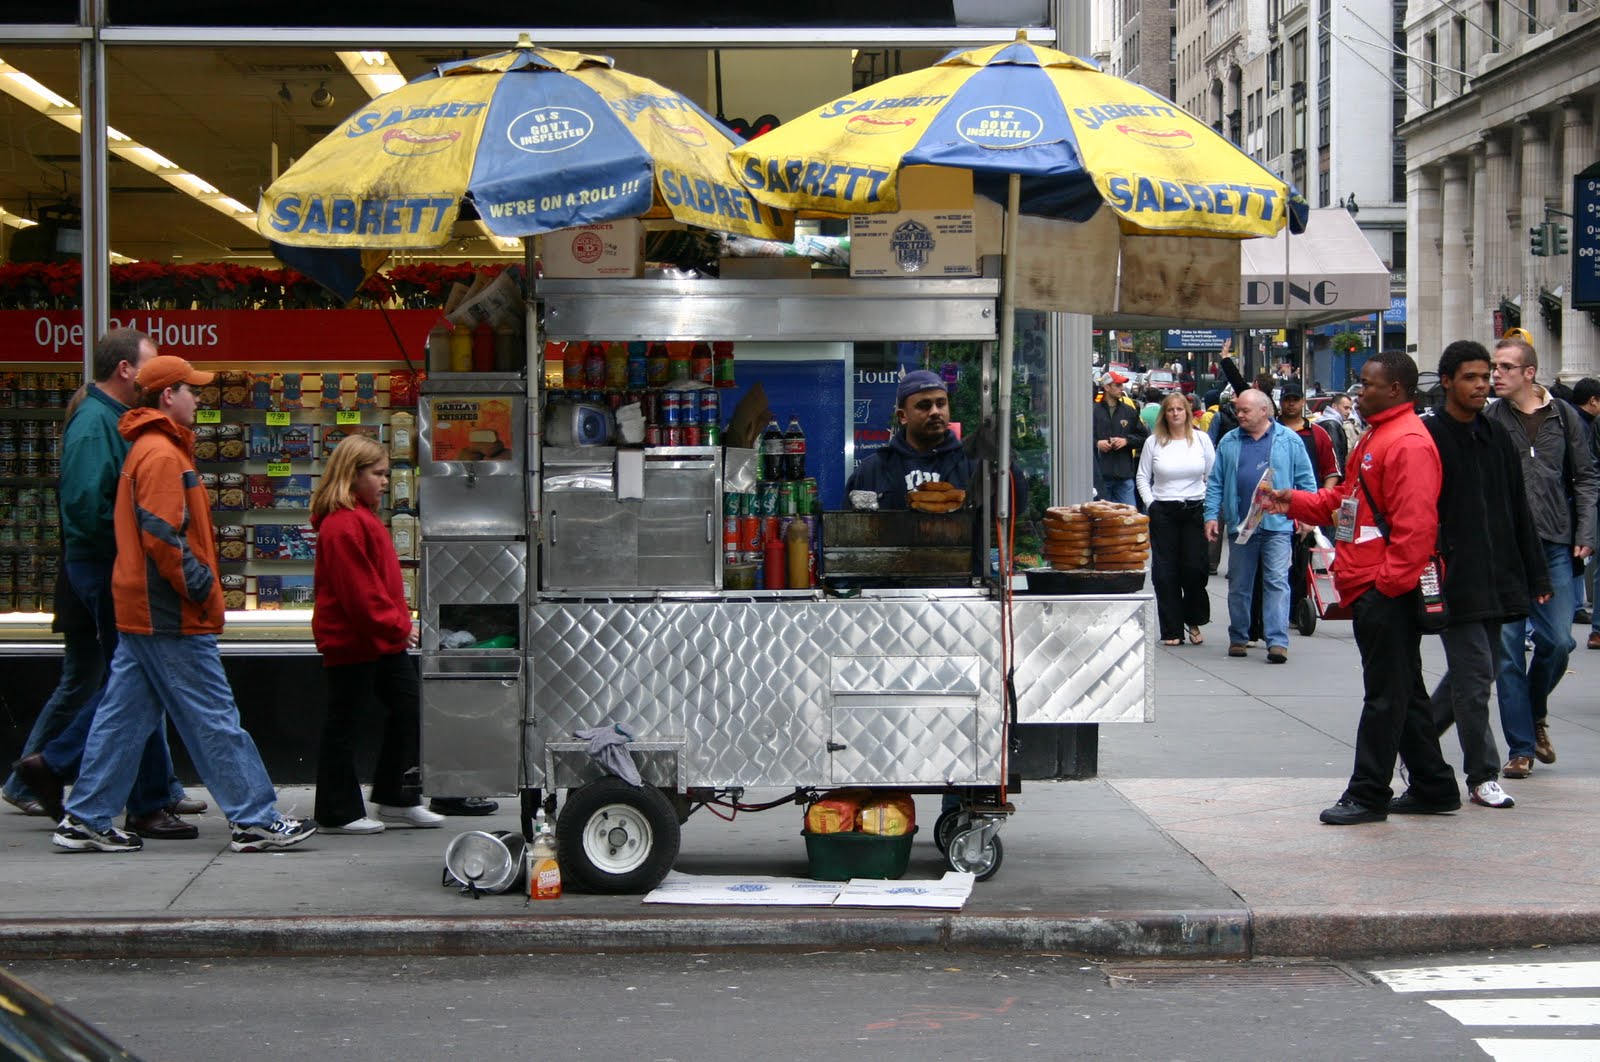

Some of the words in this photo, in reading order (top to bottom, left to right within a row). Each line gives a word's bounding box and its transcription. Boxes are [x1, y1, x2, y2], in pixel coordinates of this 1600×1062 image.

[819, 95, 948, 119] SABRETT
[1073, 104, 1176, 130] SABRETT
[345, 101, 488, 138] SABRETT
[530, 121, 570, 136] GOV'T
[979, 119, 1022, 130] GOV'T
[519, 127, 585, 146] INSPECTED
[965, 127, 1032, 139] INSPECTED
[741, 153, 890, 204] SABRETT
[489, 199, 536, 219] WE'RE
[540, 194, 562, 212] ON
[565, 193, 577, 207] A
[578, 185, 618, 206] ROLL
[620, 179, 640, 196] !!!
[1104, 173, 1278, 222] SABRETT
[269, 192, 455, 236] SABRETT
[1240, 280, 1339, 305] DING
[35, 316, 83, 353] Ope
[147, 316, 219, 346] Hours
[251, 486, 272, 494] USA
[256, 536, 277, 544] USA
[259, 588, 280, 596] USA
